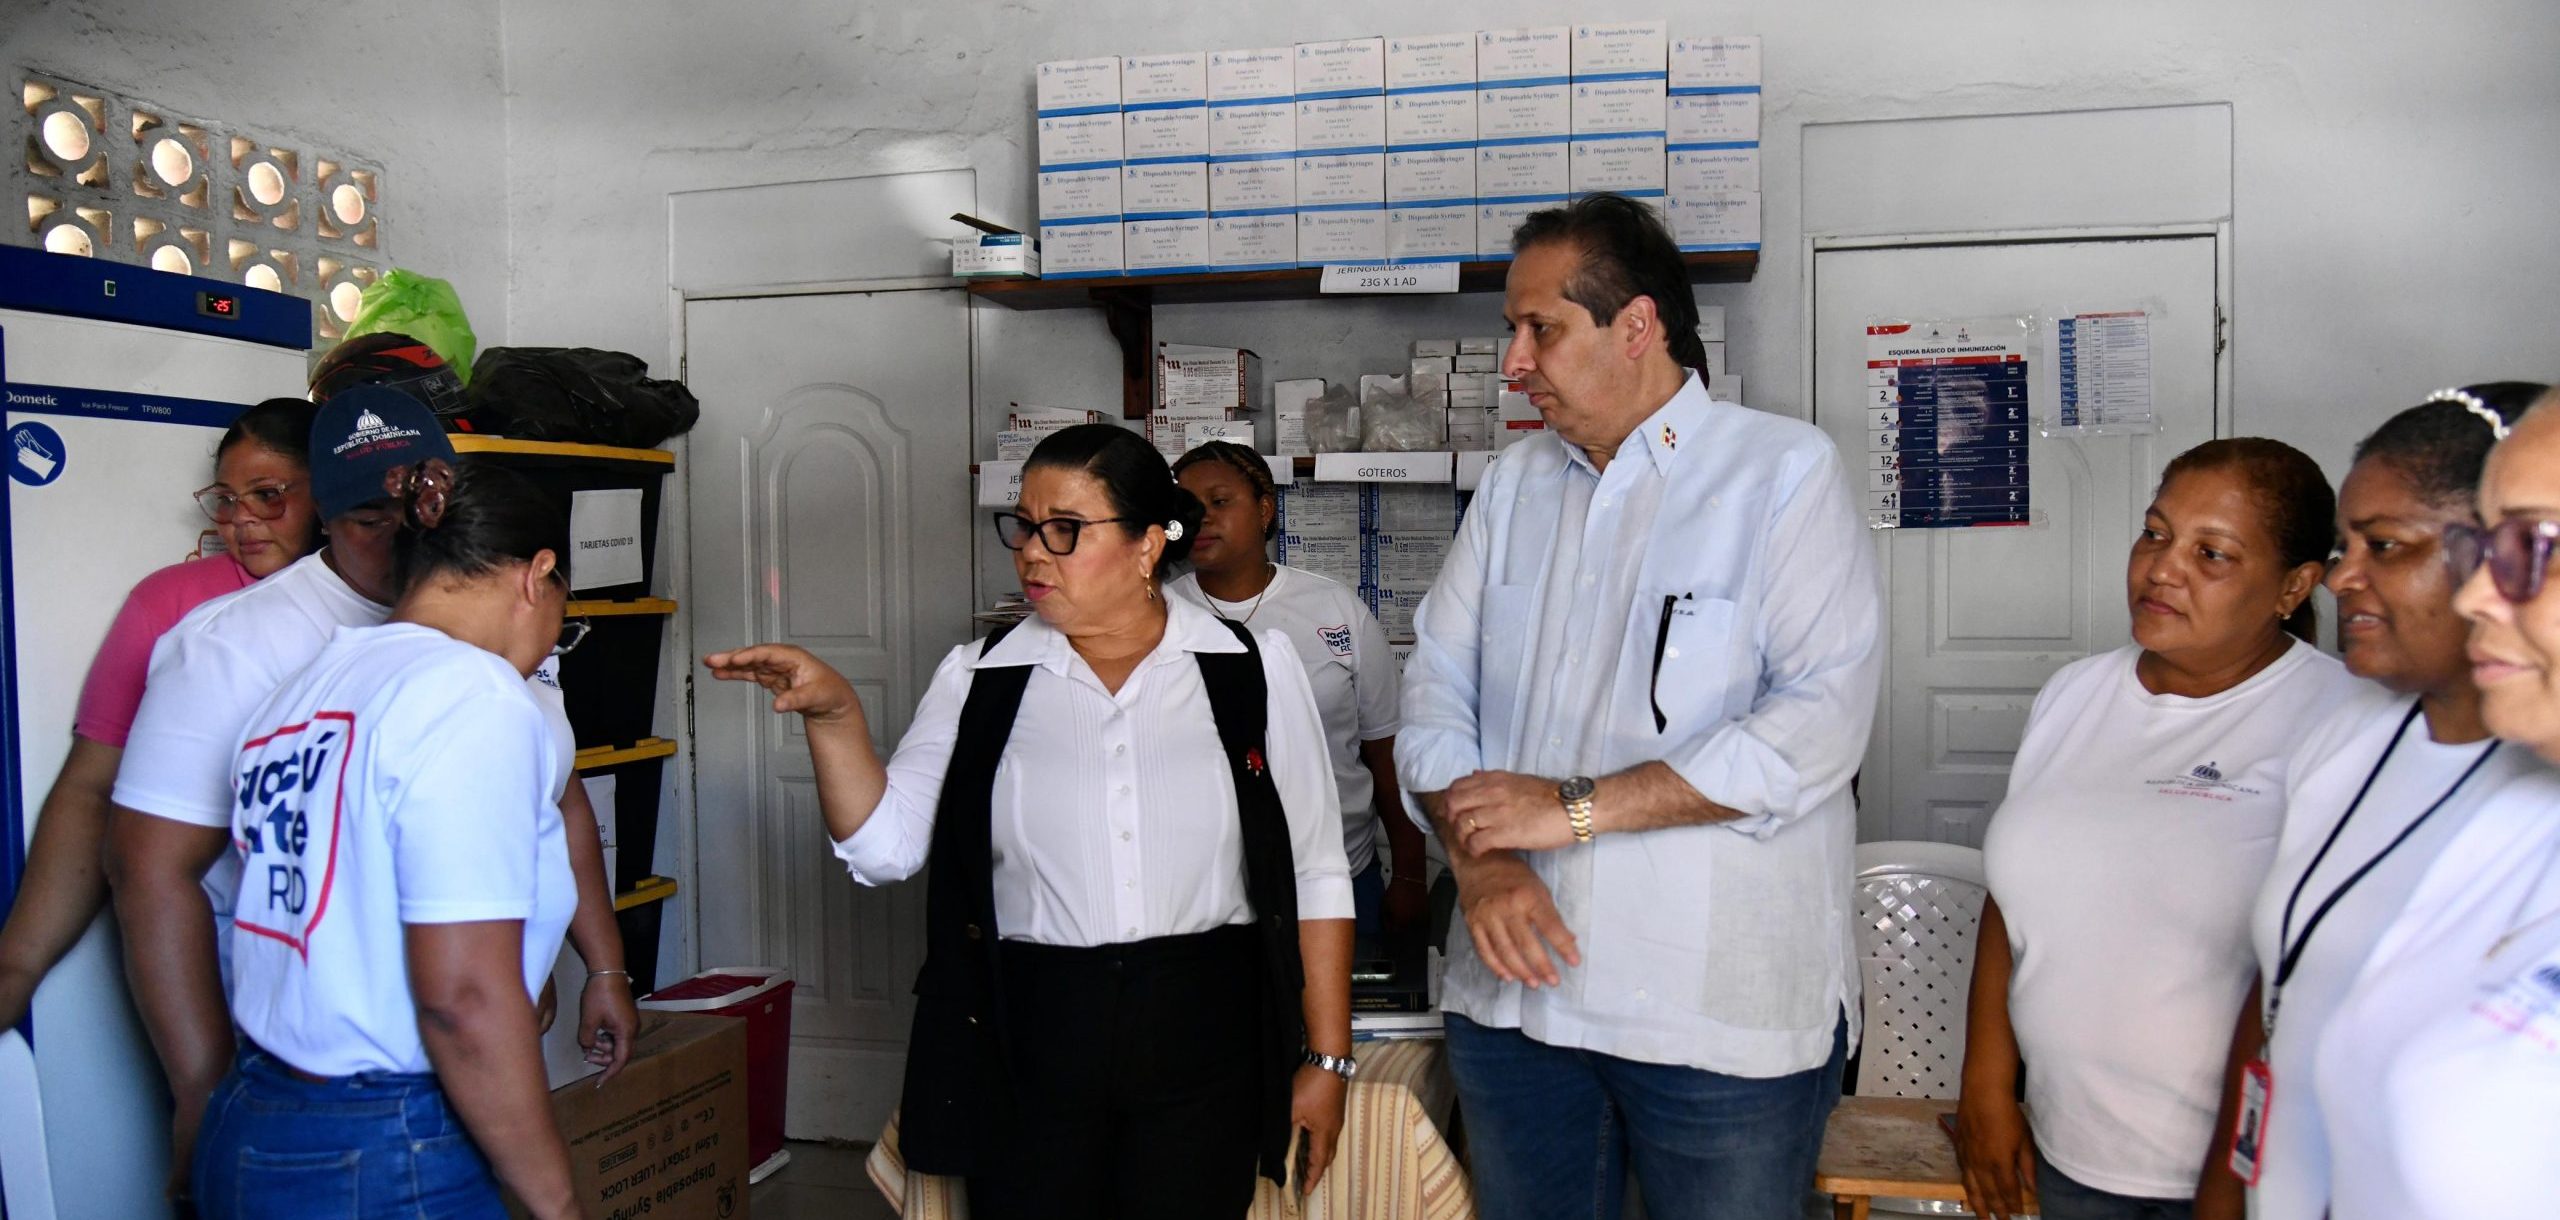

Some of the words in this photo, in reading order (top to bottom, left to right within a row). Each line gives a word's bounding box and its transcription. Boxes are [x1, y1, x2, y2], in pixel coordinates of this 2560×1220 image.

[1360, 279, 1380, 287] 23G
[1383, 278, 1390, 287] X
[1394, 278, 1398, 286] 1
[1402, 277, 1417, 286] AD
[1921, 346, 1946, 354] BÁSICO
[1958, 345, 2007, 353] INMUNIZACIÓN
[1880, 391, 1887, 400] 2
[1881, 412, 1889, 422] 4
[372, 429, 421, 441] DOMINICANA
[1881, 434, 1888, 444] 6
[1881, 456, 1892, 465] 12
[1358, 468, 1407, 478] GOTEROS
[1882, 474, 1893, 483] 18
[1882, 496, 1890, 505] 4
[580, 539, 609, 550] TARJETAS
[611, 537, 626, 546] COVID
[268, 864, 307, 915] RD
[630, 1164, 656, 1186] LUER
[656, 1161, 716, 1205] Disposable
[600, 1178, 629, 1202] LOCK
